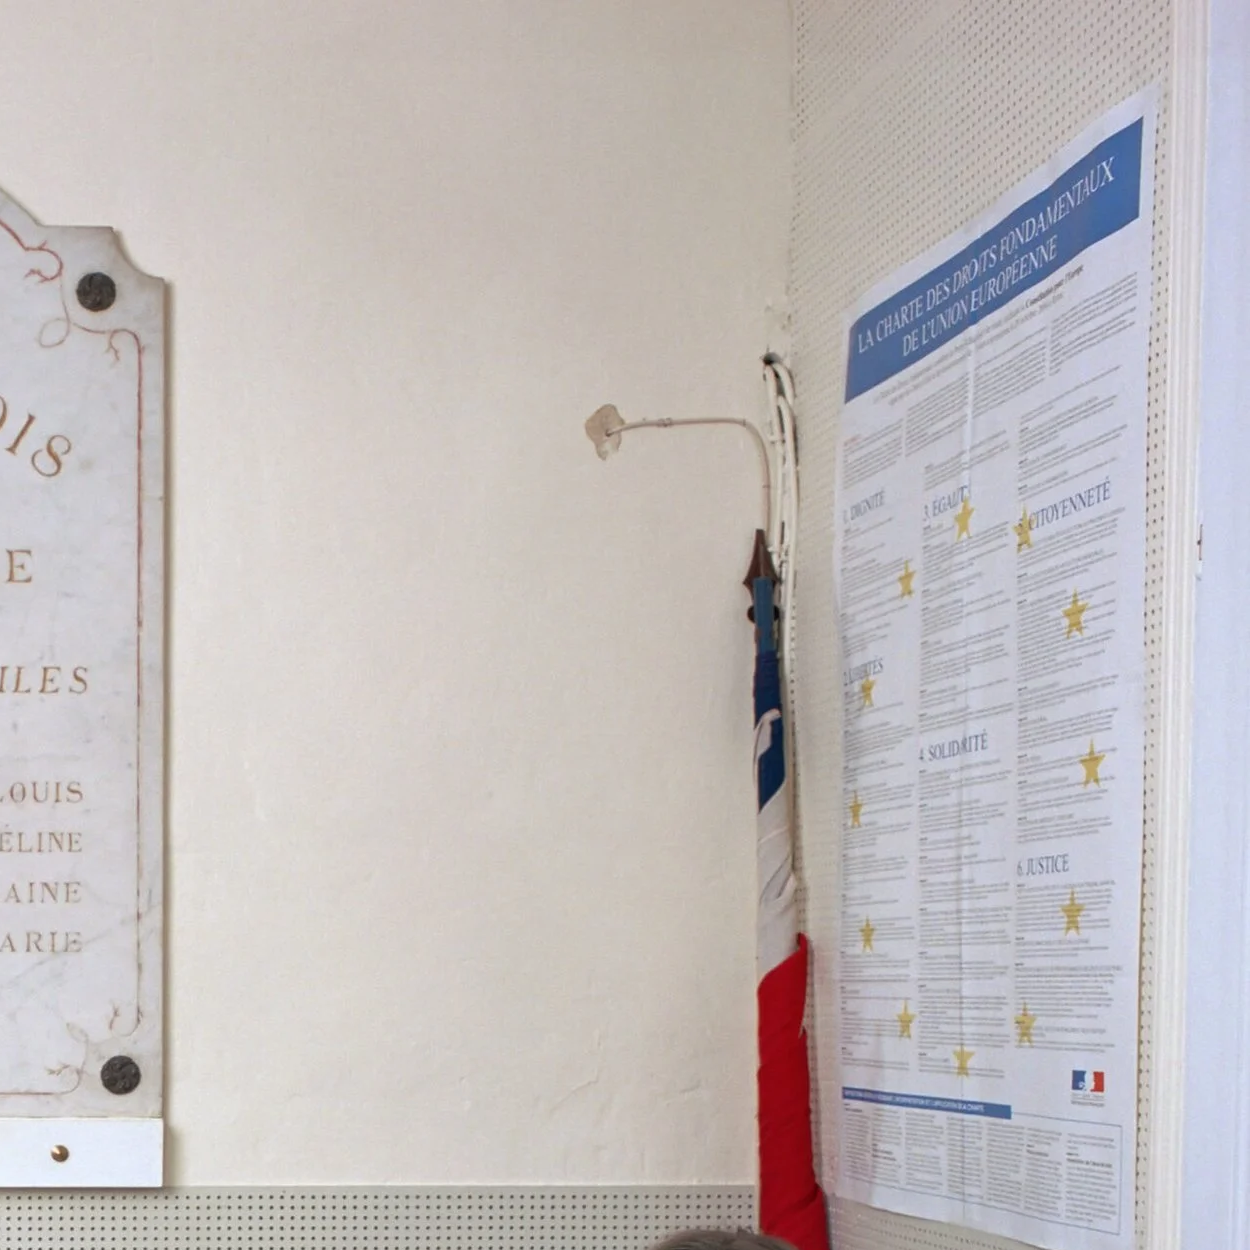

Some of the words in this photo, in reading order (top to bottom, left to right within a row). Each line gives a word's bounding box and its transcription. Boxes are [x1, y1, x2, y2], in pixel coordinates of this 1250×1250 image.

[858, 331, 874, 354] LA
[877, 299, 923, 342] CHARTE
[926, 276, 952, 312] DES
[953, 243, 998, 298] DROITS
[1000, 156, 1116, 261] FONDAMENTAUX
[903, 331, 919, 357] DE
[969, 234, 1059, 312] EUROPÉENNE
[1028, 475, 1111, 531] CITOYENNETÉ
[1025, 853, 1070, 877] JUSTICE
